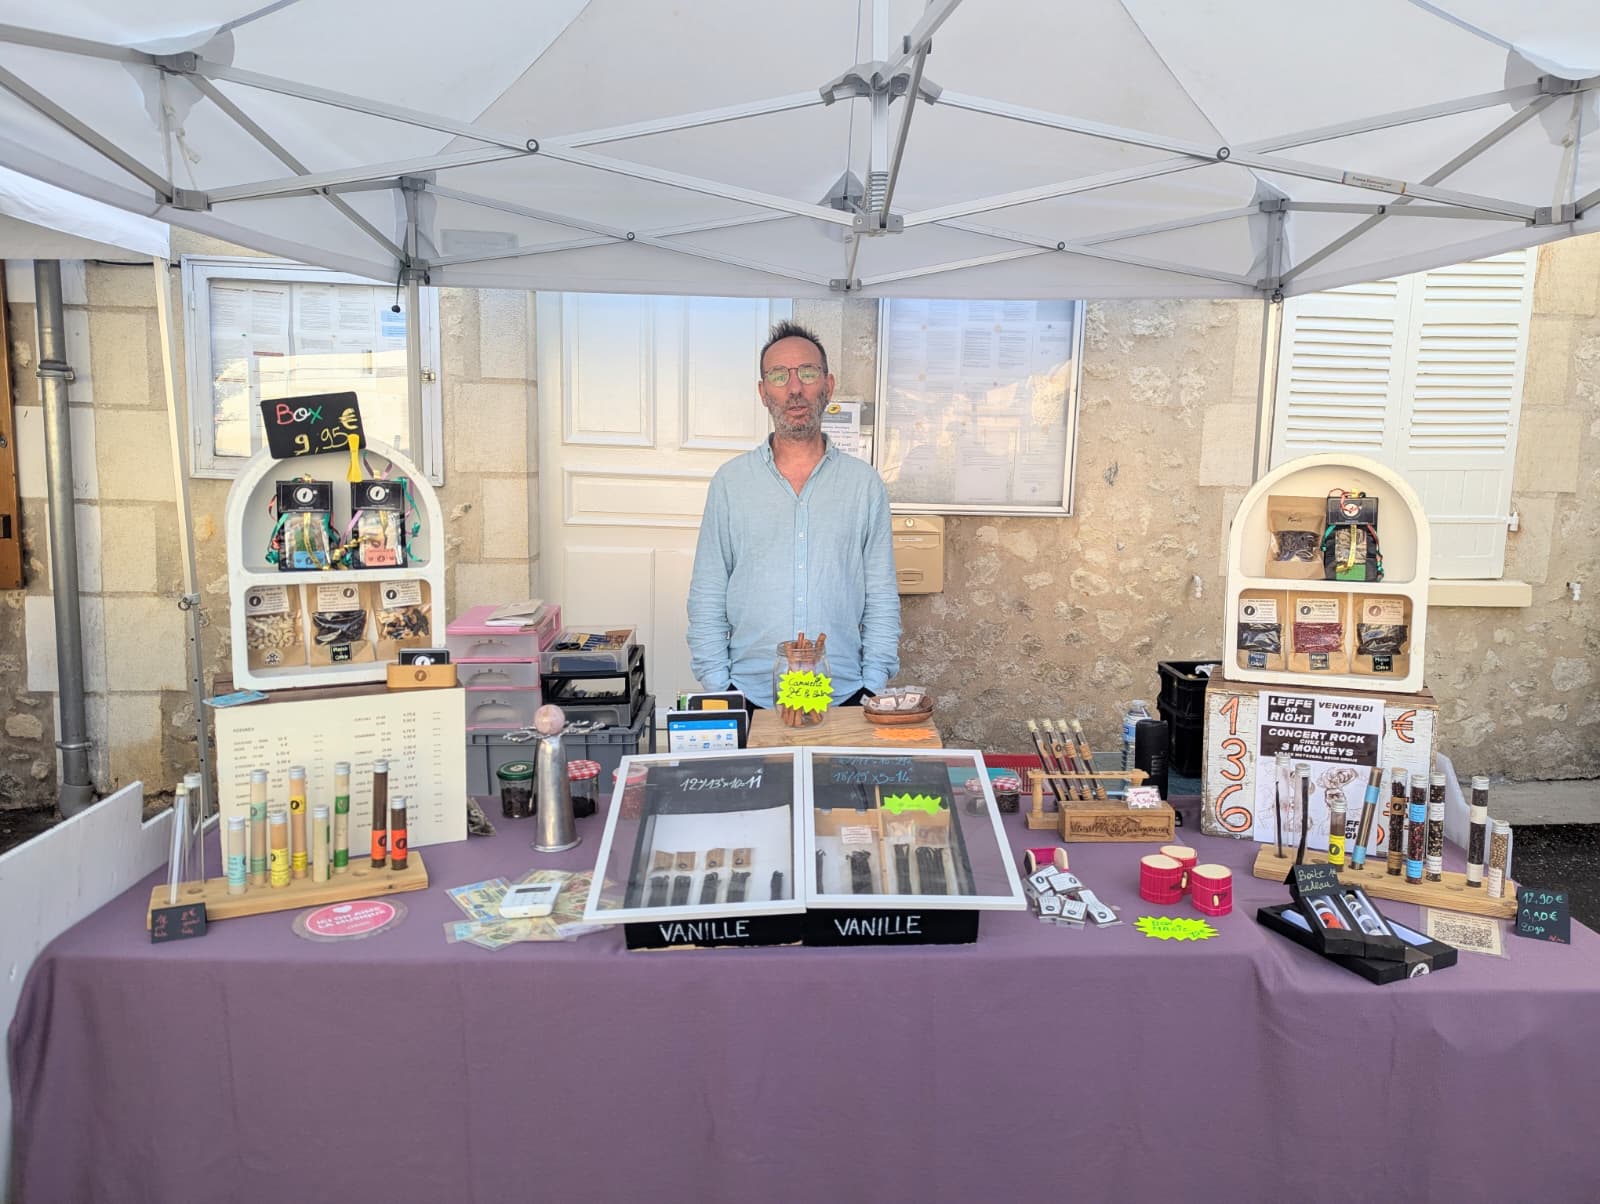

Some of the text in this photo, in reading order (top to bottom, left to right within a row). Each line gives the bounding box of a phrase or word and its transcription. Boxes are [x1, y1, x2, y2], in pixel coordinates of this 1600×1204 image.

[1270, 697, 1313, 708] LEFFE
[1318, 701, 1374, 713] VENDREDI
[1270, 711, 1312, 723] RIGHT
[1342, 711, 1362, 720] MAI
[1334, 719, 1355, 728] 21H
[1268, 728, 1366, 744] CONCERT ROCK
[1299, 738, 1319, 746] CHEZ
[1292, 743, 1355, 757] MONKEYS
[1220, 738, 1247, 781] 3
[1215, 783, 1252, 833] 6
[658, 919, 750, 943] VANILLE
[834, 915, 922, 937] VANILLE
